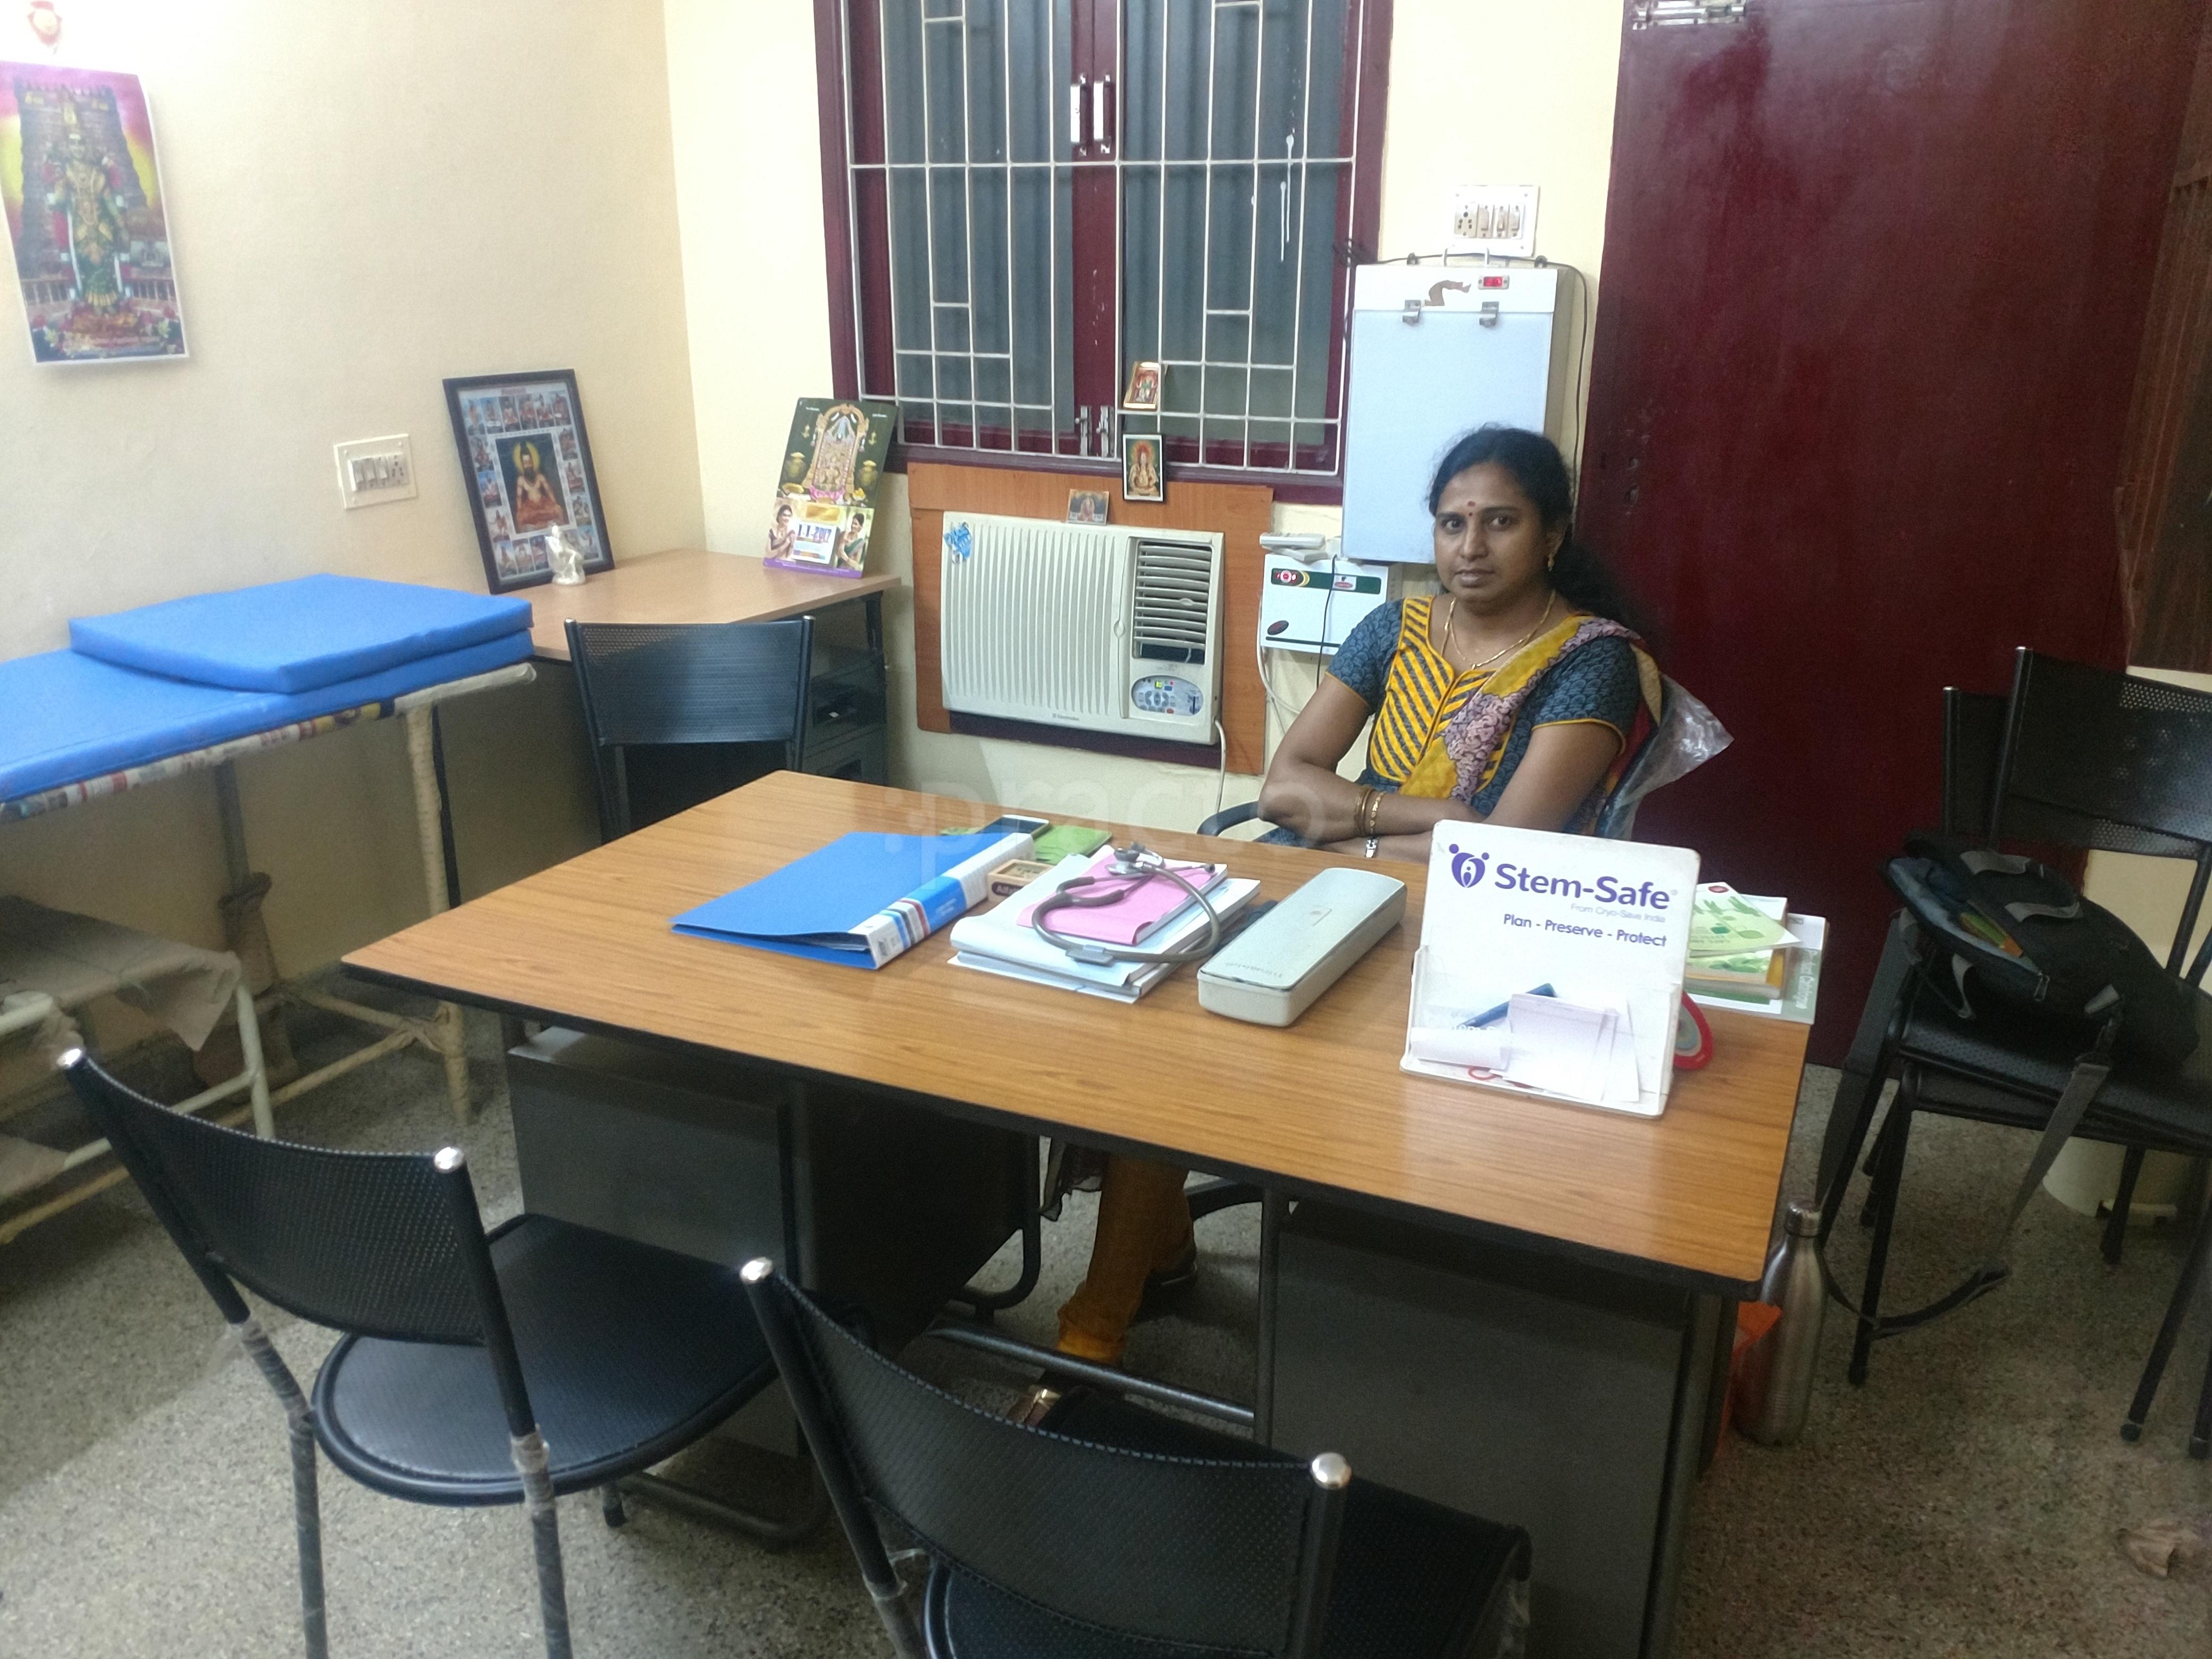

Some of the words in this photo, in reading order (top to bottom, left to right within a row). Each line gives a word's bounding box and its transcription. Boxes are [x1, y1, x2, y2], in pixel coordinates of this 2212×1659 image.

[1495, 864, 1670, 909] Stem-Safe
[1503, 914, 1531, 928] Plan
[1545, 919, 1603, 937] Preserve
[1616, 929, 1668, 946] Protect
